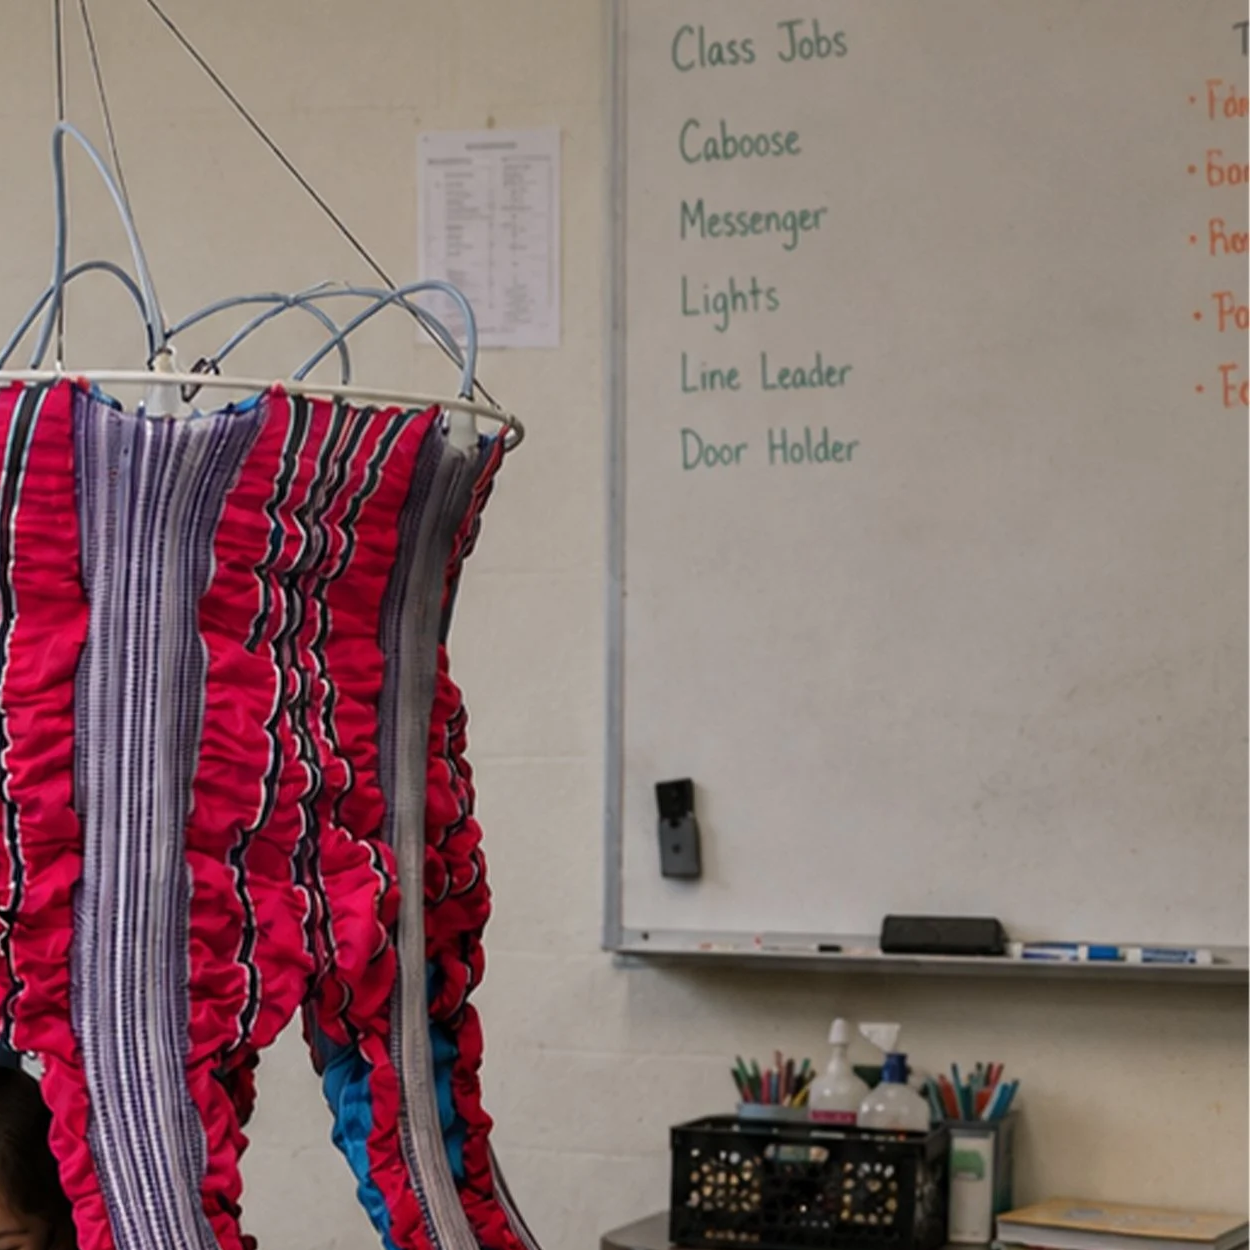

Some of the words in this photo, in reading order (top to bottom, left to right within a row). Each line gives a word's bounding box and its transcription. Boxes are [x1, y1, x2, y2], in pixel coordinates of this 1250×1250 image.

[671, 24, 756, 73] Class
[776, 18, 849, 63] Jobs
[678, 117, 803, 165] Caboose
[679, 197, 829, 252] Messenger
[681, 273, 781, 334] Lights
[681, 351, 742, 395] Line
[759, 350, 854, 392] Leader
[680, 427, 749, 473] Door
[767, 425, 861, 466] Holder
